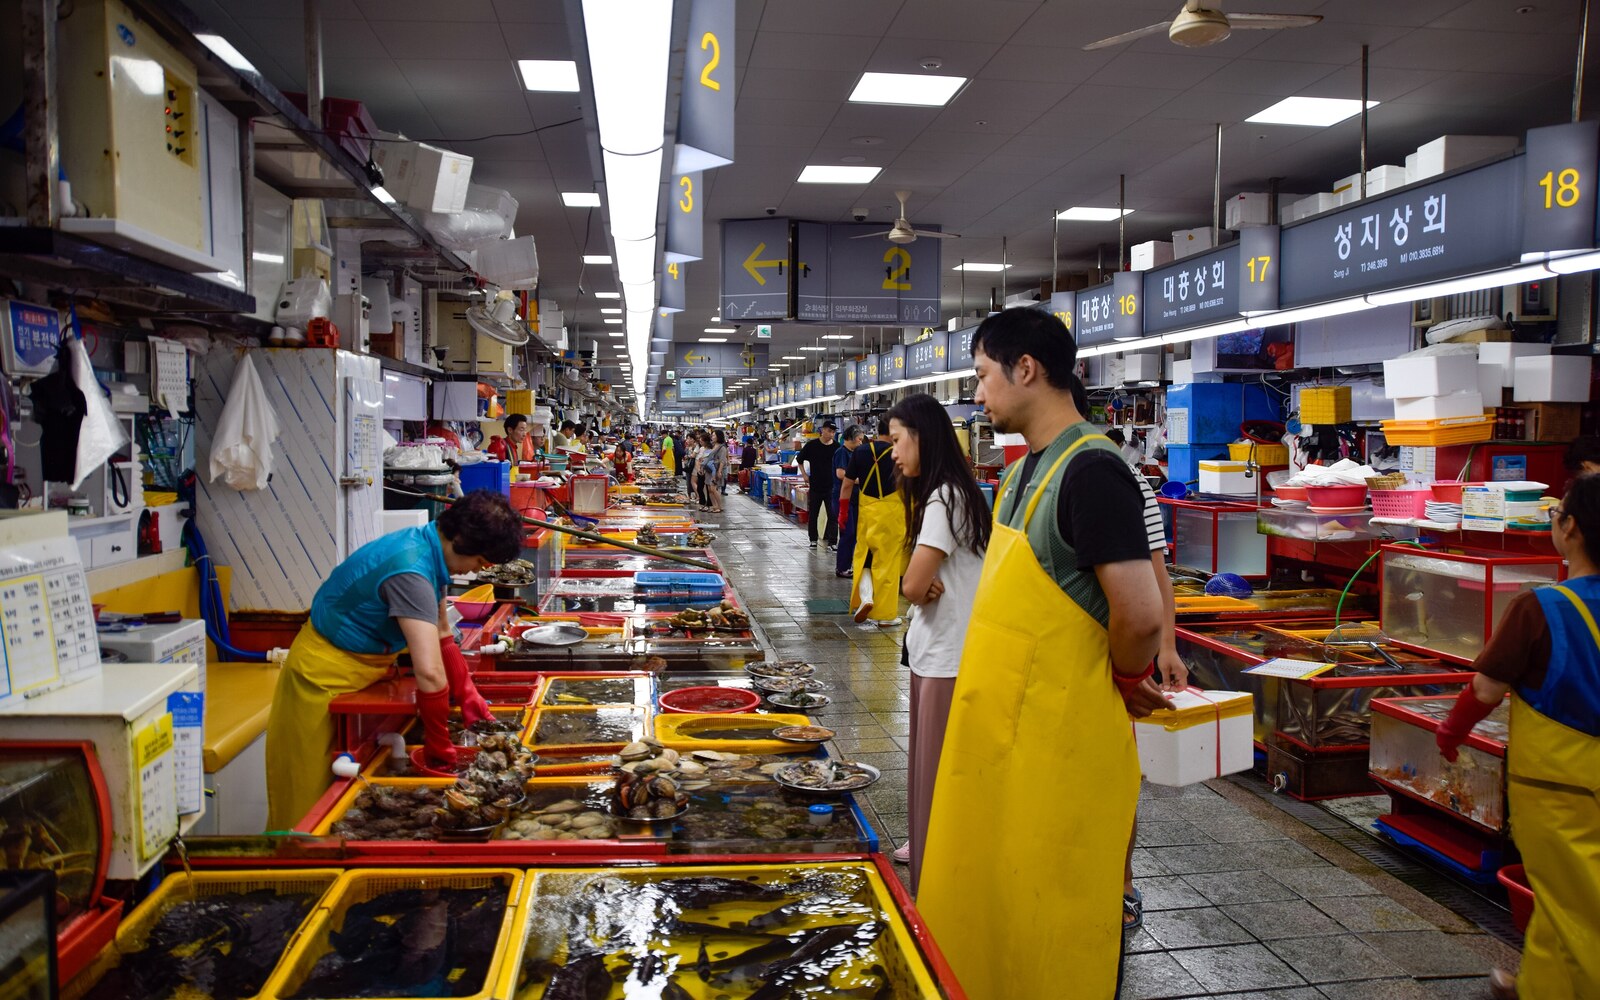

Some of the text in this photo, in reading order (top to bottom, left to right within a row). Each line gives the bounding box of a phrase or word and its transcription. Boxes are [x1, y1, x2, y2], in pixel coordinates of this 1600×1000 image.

[699, 31, 721, 91] 2
[679, 176, 694, 213] 3
[1539, 168, 1580, 209] 18
[1334, 194, 1446, 260] 성지상회
[668, 262, 679, 280] 4
[882, 246, 912, 291] 2
[1163, 260, 1225, 303] 대흥상회
[1247, 255, 1271, 283] 17
[1082, 294, 1115, 322] 대흥상
[1119, 294, 1136, 315] 16
[895, 356, 903, 369] 13
[935, 346, 944, 358] 14
[848, 371, 855, 381] 11
[869, 364, 877, 376] 12
